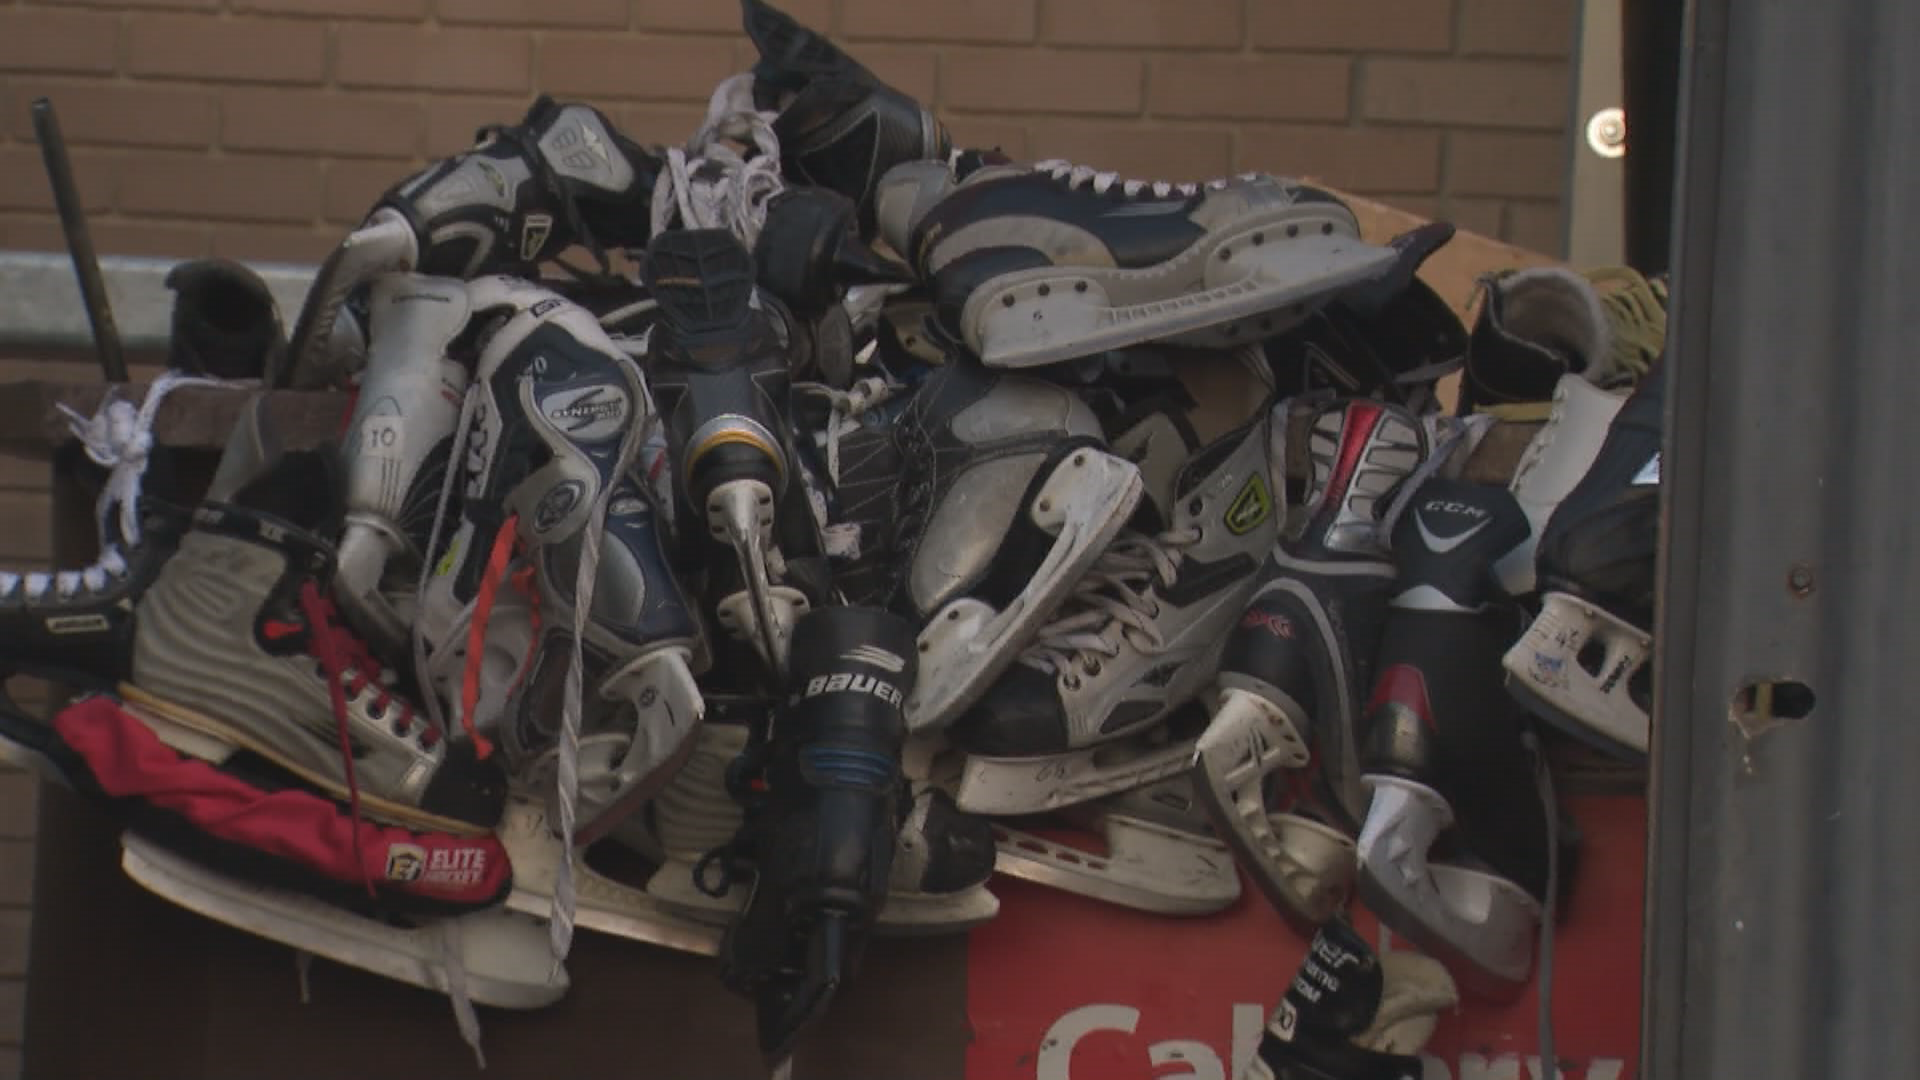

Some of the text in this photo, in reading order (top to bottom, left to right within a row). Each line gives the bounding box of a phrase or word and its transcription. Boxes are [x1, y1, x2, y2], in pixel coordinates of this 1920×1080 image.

[1424, 500, 1487, 518] CCM
[805, 673, 903, 709] BAUER
[429, 847, 487, 870] ELITE
[1036, 1003, 1624, 1080] Calry
